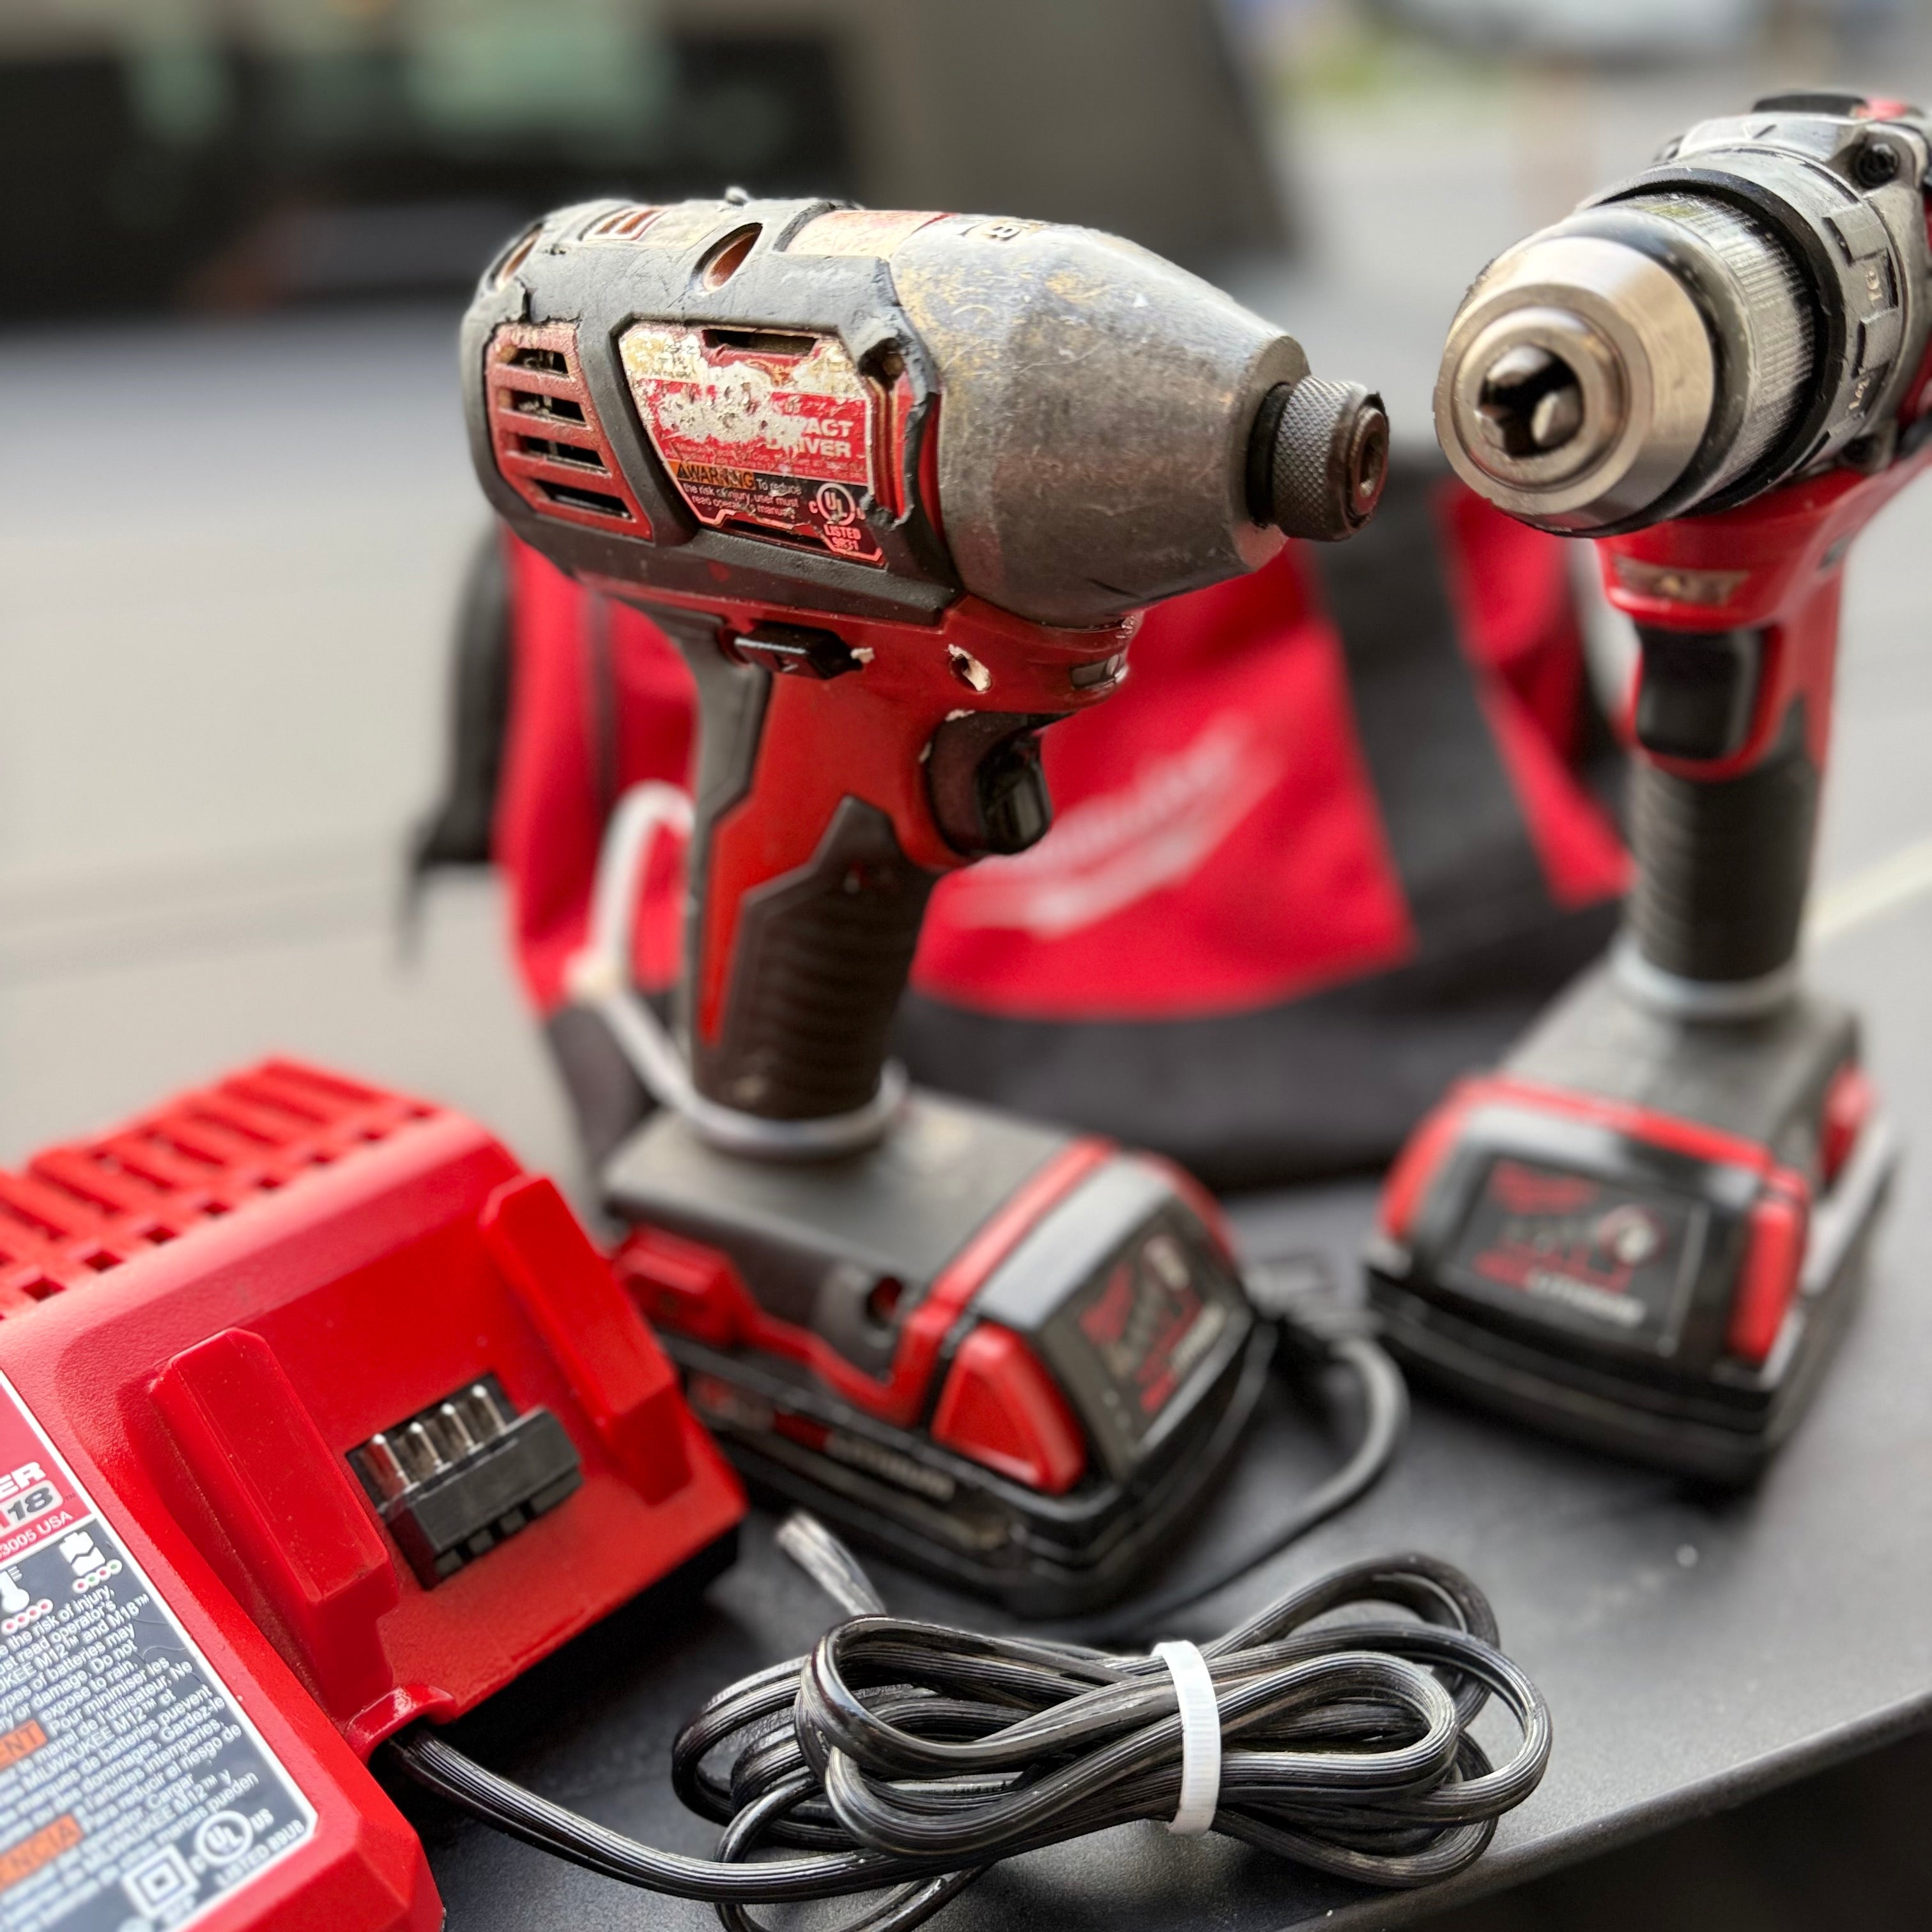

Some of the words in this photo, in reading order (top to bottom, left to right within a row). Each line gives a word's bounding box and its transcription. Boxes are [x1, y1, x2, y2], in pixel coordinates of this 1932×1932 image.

[776, 413, 854, 438] ACT
[683, 483, 698, 493] the
[699, 487, 715, 496] risk
[754, 494, 774, 503] user
[775, 497, 799, 507] must
[756, 479, 768, 491] To
[824, 524, 861, 540] LISTED
[0, 1487, 54, 1528] 18
[0, 1528, 38, 1558] 3005
[36, 1510, 73, 1535] USA
[7, 1631, 32, 1651] the
[32, 1616, 59, 1637] risk
[58, 1604, 73, 1621] of
[72, 1585, 114, 1613] injury,
[17, 1636, 50, 1665] read
[49, 1597, 116, 1648] operator's
[82, 1619, 109, 1643] and
[15, 1703, 31, 1720] or
[31, 1664, 93, 1712] damage.
[89, 1653, 113, 1674] Do
[112, 1639, 137, 1662] not
[30, 1672, 47, 1694] of
[45, 1641, 105, 1682] batteries
[105, 1623, 134, 1652] may
[39, 1687, 91, 1726] expose
[86, 1672, 107, 1692] to
[46, 1708, 82, 1736] Pour
[83, 1669, 147, 1715] minimiser
[146, 1657, 170, 1676] les
[73, 1719, 101, 1738] de
[167, 1662, 192, 1680] Ne
[156, 1692, 228, 1742] Gardez-le
[22, 1726, 114, 1790] MILWAUKEE
[158, 1689, 176, 1706] et
[79, 1757, 100, 1774] de
[97, 1720, 162, 1763] batteries
[157, 1684, 217, 1731] puevent
[116, 1772, 165, 1809] reducir
[165, 1761, 181, 1779] el
[180, 1737, 222, 1776] riesgo
[217, 1724, 241, 1743] de
[220, 1770, 236, 1790] y
[146, 1774, 201, 1816] Cargar
[201, 1772, 259, 1817] pueden
[250, 1809, 274, 1832] US
